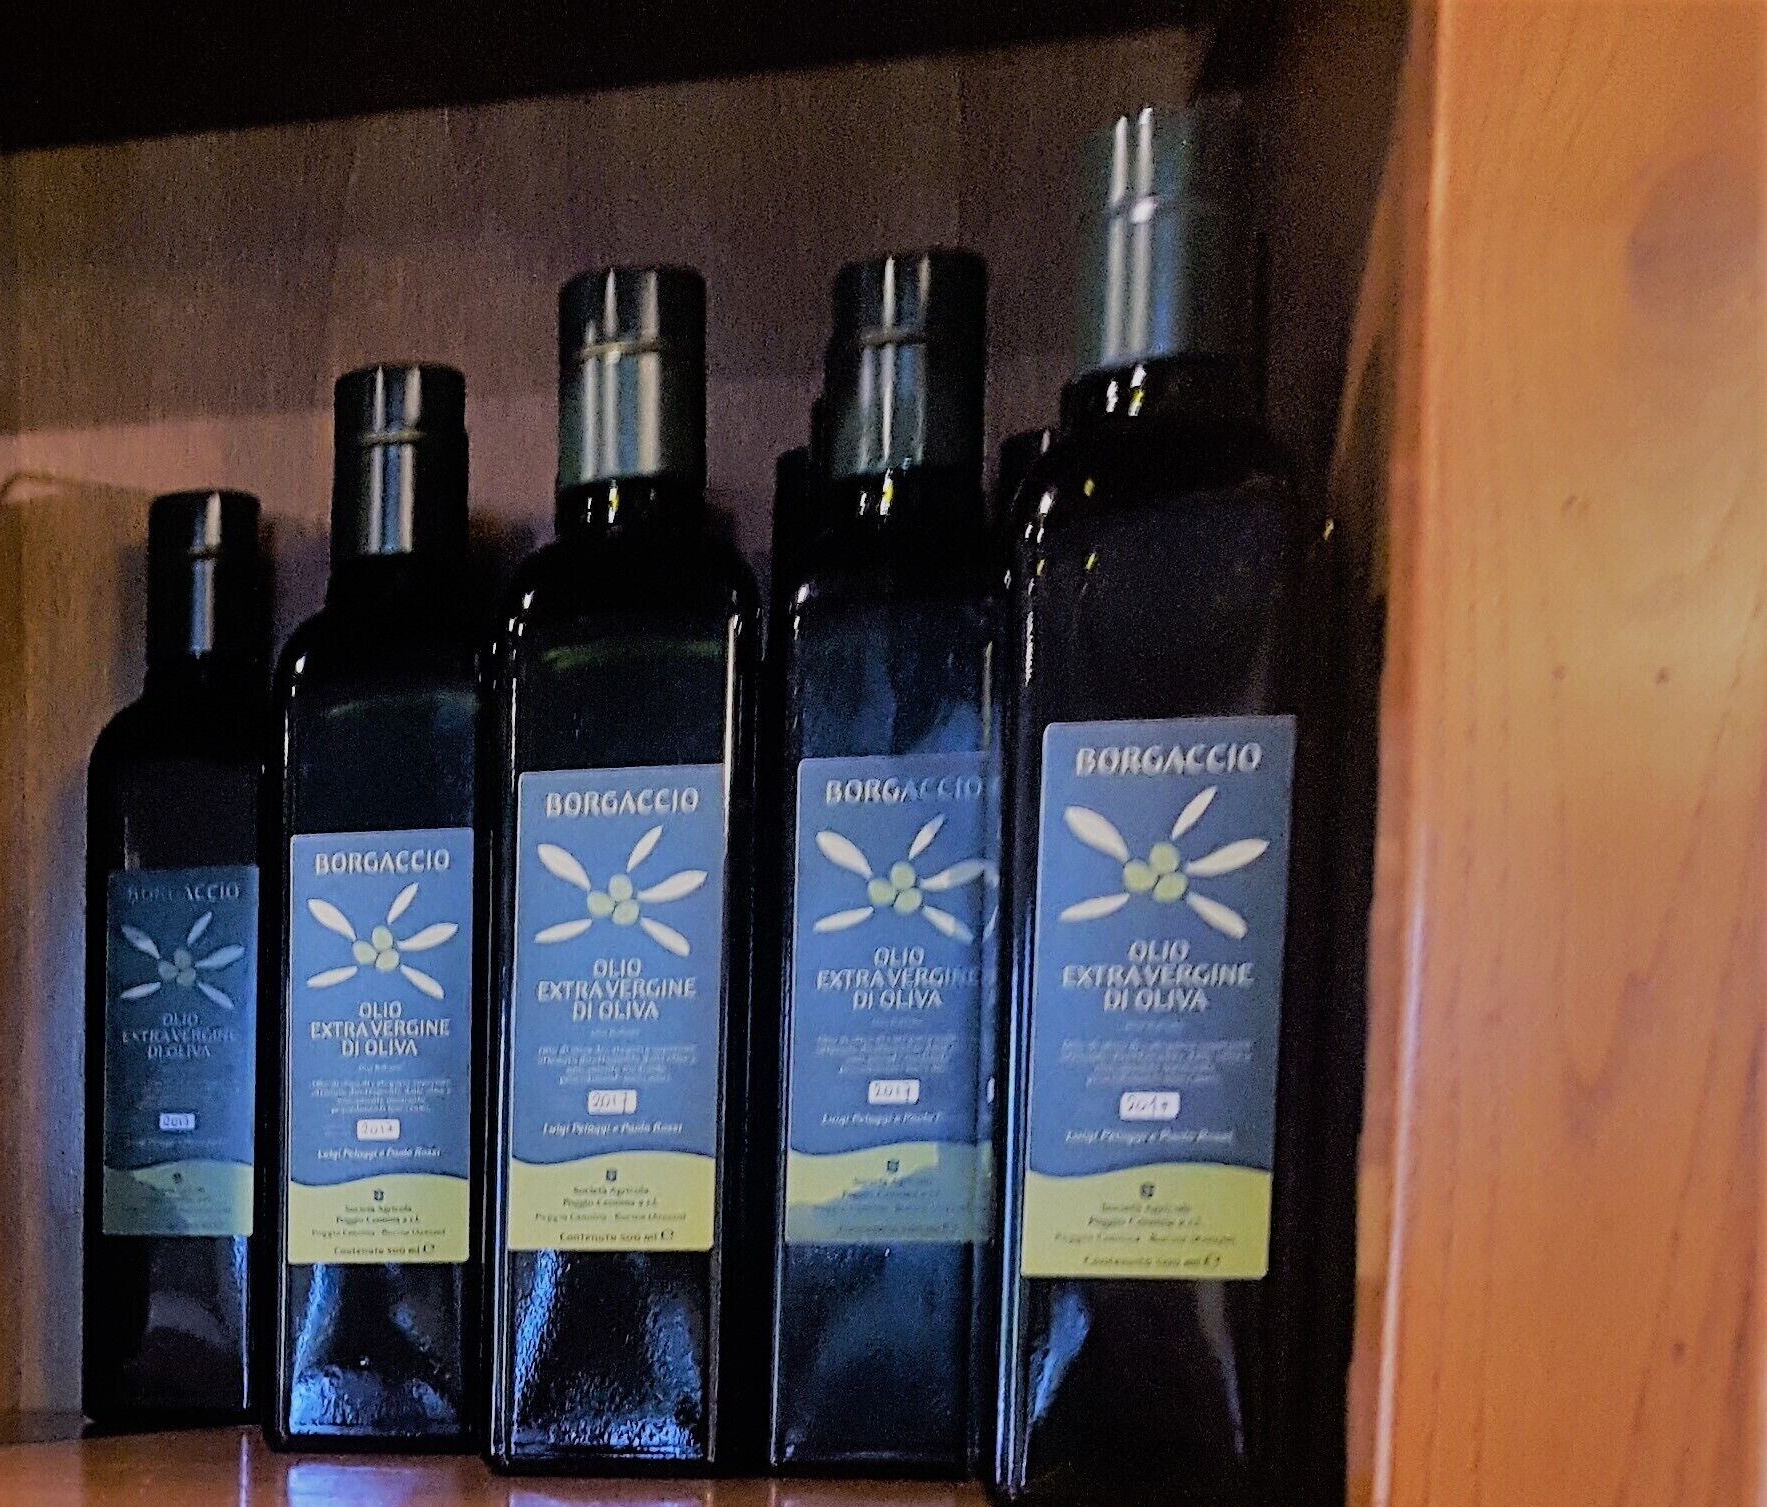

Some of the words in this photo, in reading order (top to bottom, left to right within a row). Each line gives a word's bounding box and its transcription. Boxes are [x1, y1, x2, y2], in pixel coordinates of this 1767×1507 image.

[1075, 742, 1263, 777] BORGACCIO
[826, 776, 983, 805] BORGACCIO
[546, 787, 700, 819] BORGACCIO
[315, 849, 450, 876] BORGACCIO
[874, 946, 925, 967] OLIO
[1128, 939, 1191, 962] OLIO
[593, 958, 642, 979] OLIO
[359, 1000, 402, 1018] OLIO
[573, 1000, 592, 1022] DI
[599, 1000, 660, 1021] OLIVA
[852, 990, 875, 1011] DI
[881, 989, 944, 1010] OLIVA
[1103, 988, 1129, 1013] DI
[1135, 987, 1210, 1012] OLIVA
[342, 1039, 359, 1057] DI
[364, 1038, 418, 1056] OLIVA
